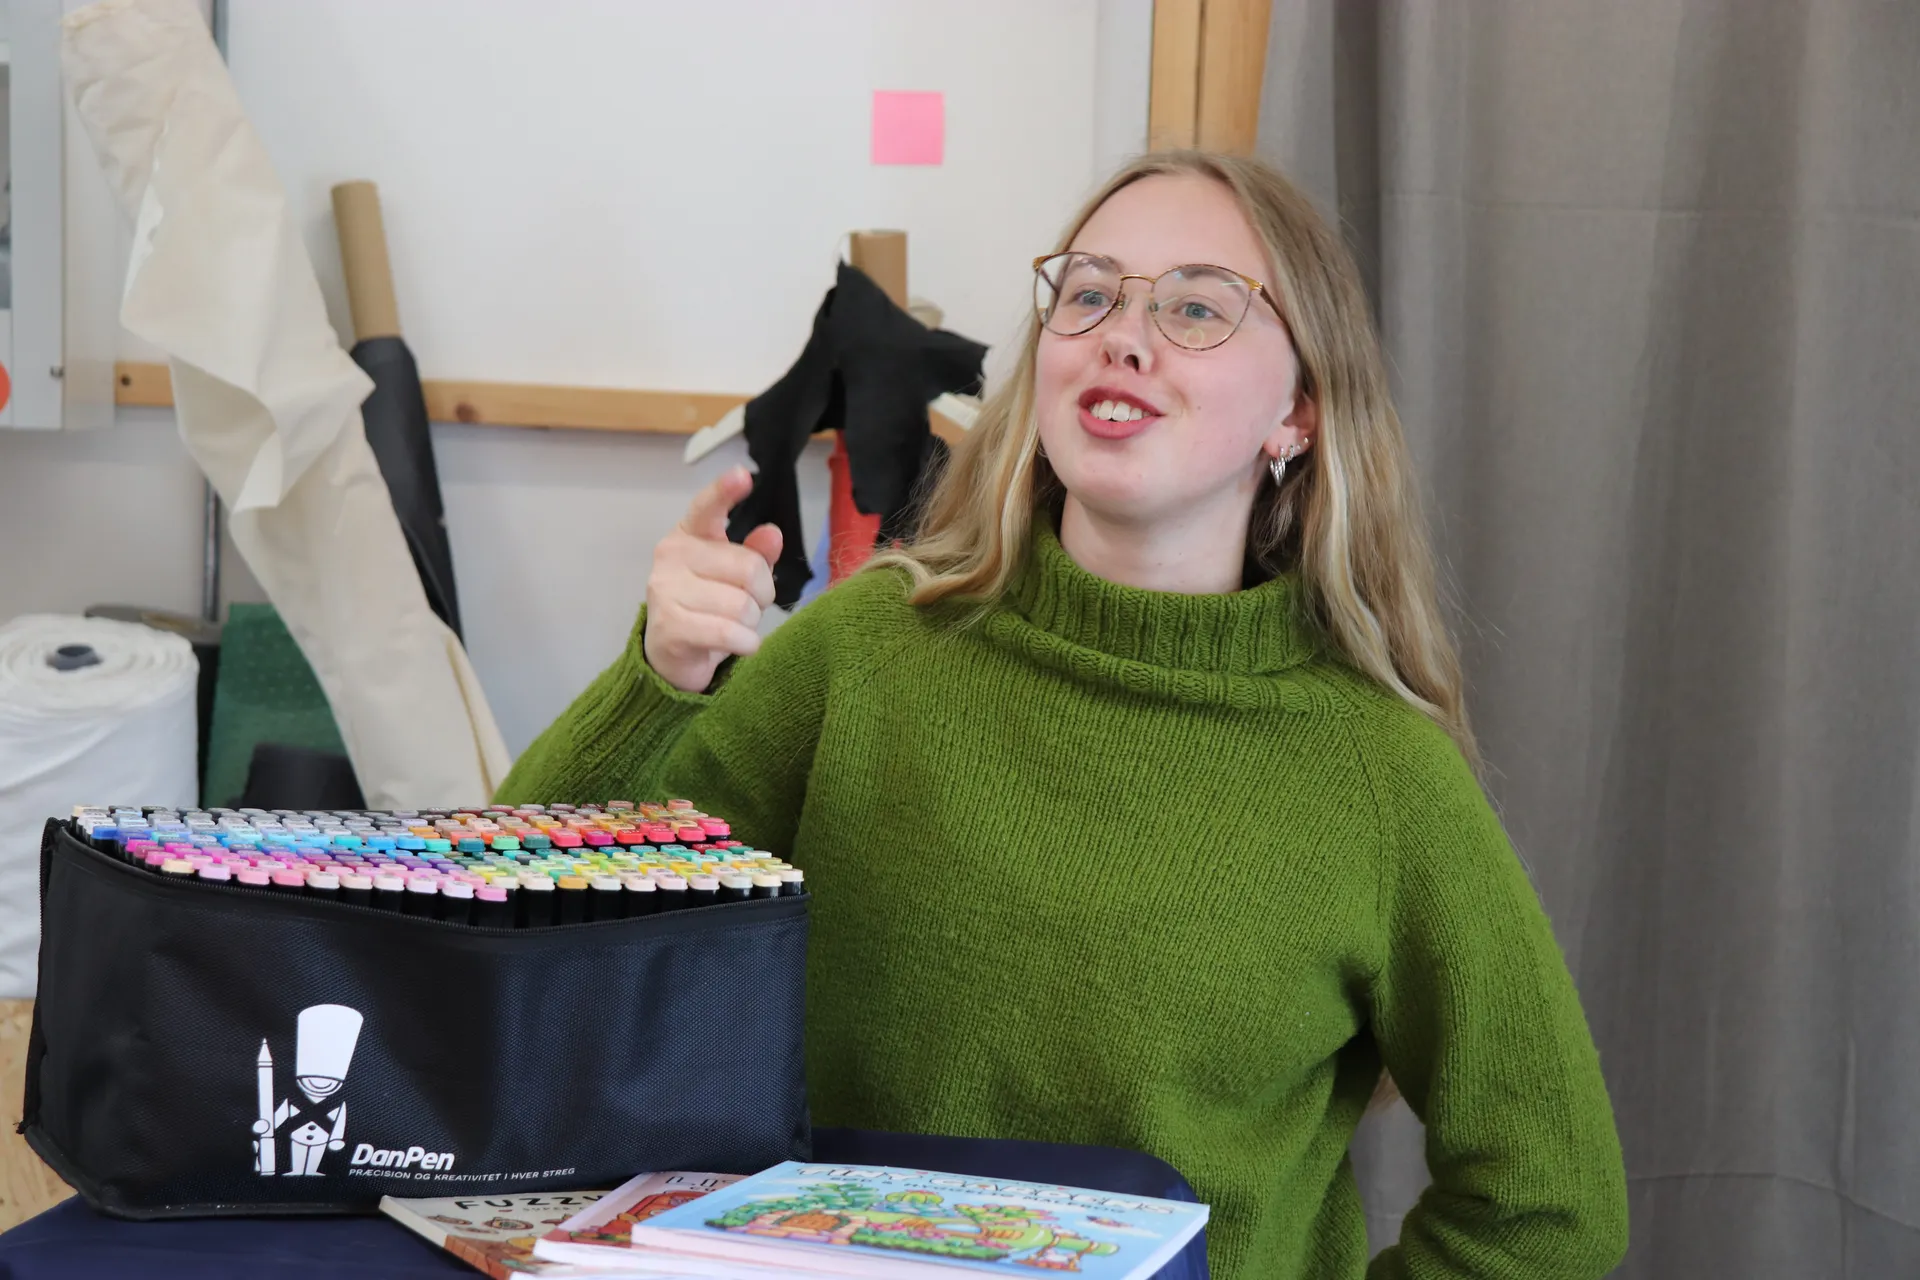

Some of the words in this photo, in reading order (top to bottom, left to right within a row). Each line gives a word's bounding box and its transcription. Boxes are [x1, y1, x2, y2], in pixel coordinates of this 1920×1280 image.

[351, 1143, 455, 1171] DanPen
[348, 1168, 411, 1179] PRÆCISION
[434, 1173, 501, 1181] KREATIVITET
[511, 1171, 539, 1180] HVER
[542, 1167, 576, 1178] STREG
